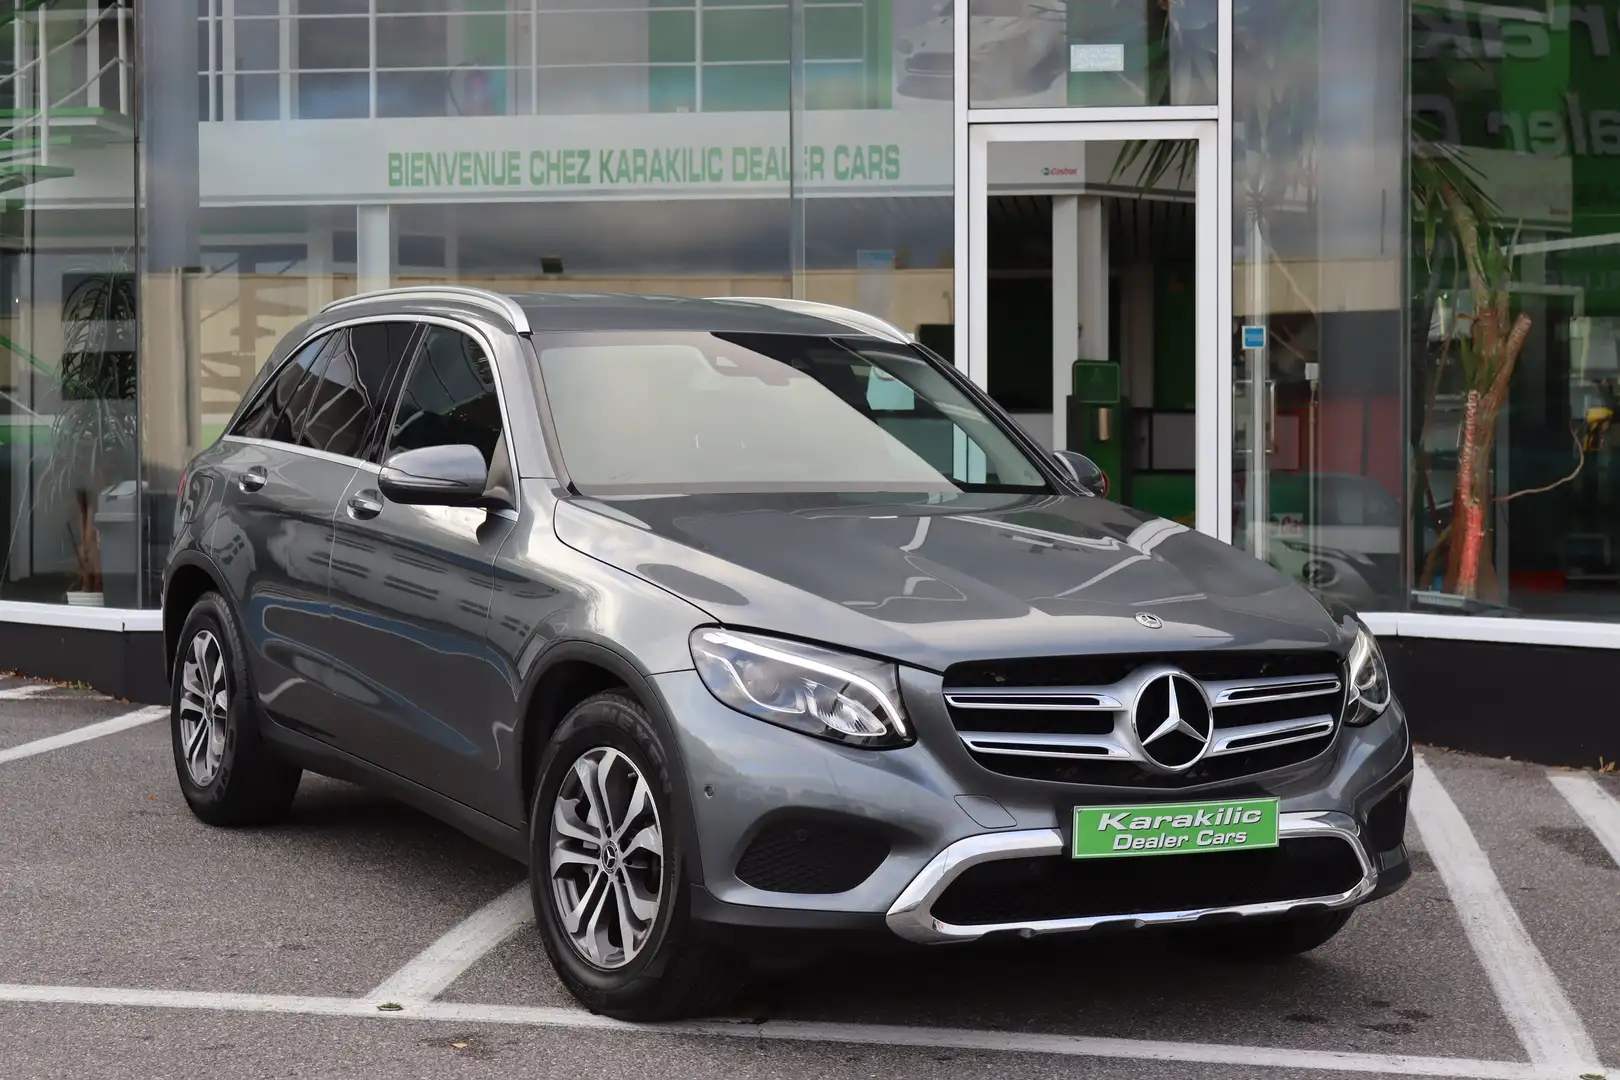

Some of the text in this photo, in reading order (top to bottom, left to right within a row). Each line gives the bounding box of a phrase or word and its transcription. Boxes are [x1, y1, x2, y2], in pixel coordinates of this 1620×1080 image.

[388, 151, 521, 187] BIENVENUE
[529, 149, 592, 185] CHEZ
[599, 148, 724, 184] KARAKILIC
[833, 144, 901, 181] CARS
[1097, 806, 1263, 832] Karakilic
[1112, 829, 1248, 851] Dealer Cars
